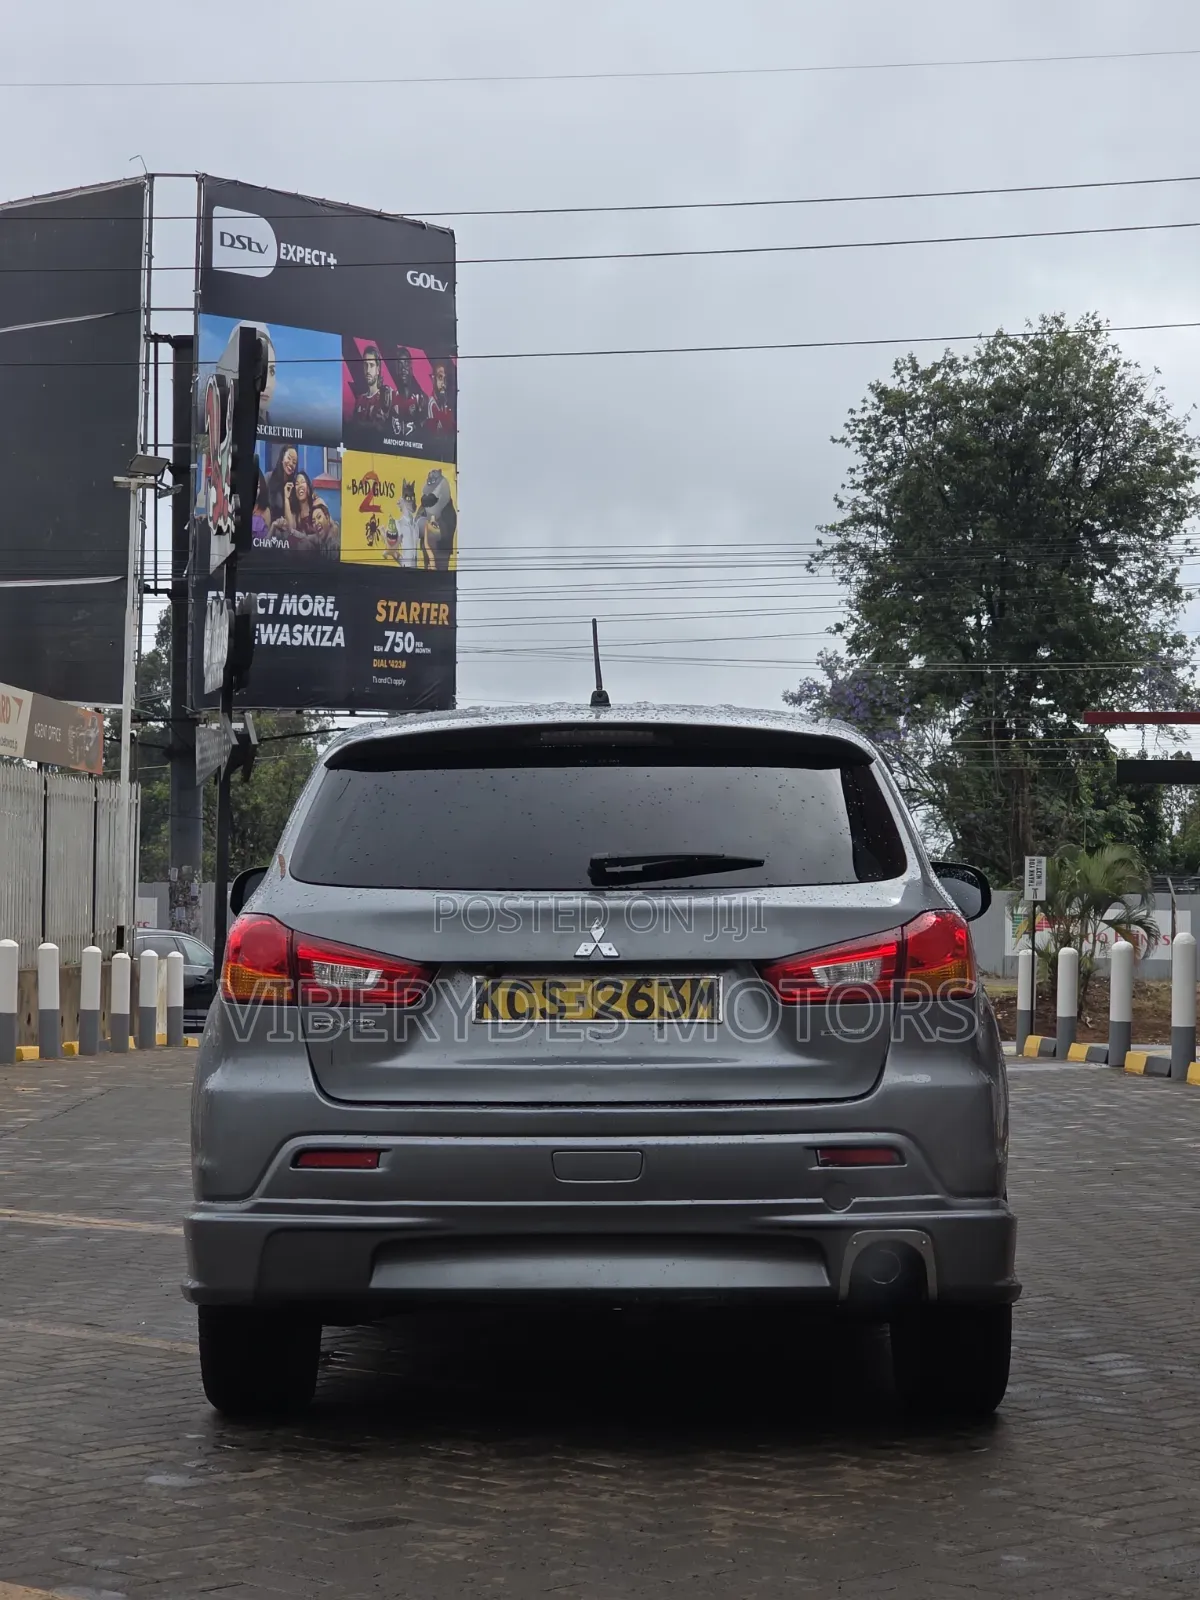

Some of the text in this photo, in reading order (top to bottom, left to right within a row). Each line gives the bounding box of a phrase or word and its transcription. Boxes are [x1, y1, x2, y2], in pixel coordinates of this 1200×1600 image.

[256, 424, 303, 439] SECRET TRUTH
[383, 437, 398, 446] MATCH
[351, 479, 371, 496] BAD
[372, 480, 395, 498] GUYS
[279, 593, 339, 621] MORE,
[376, 600, 449, 625] STARTER
[254, 623, 346, 648] WASKIZA
[384, 630, 415, 653] 750
[372, 658, 388, 668] DIAL
[393, 678, 406, 686] apply
[475, 978, 719, 1020] KCS 263M
